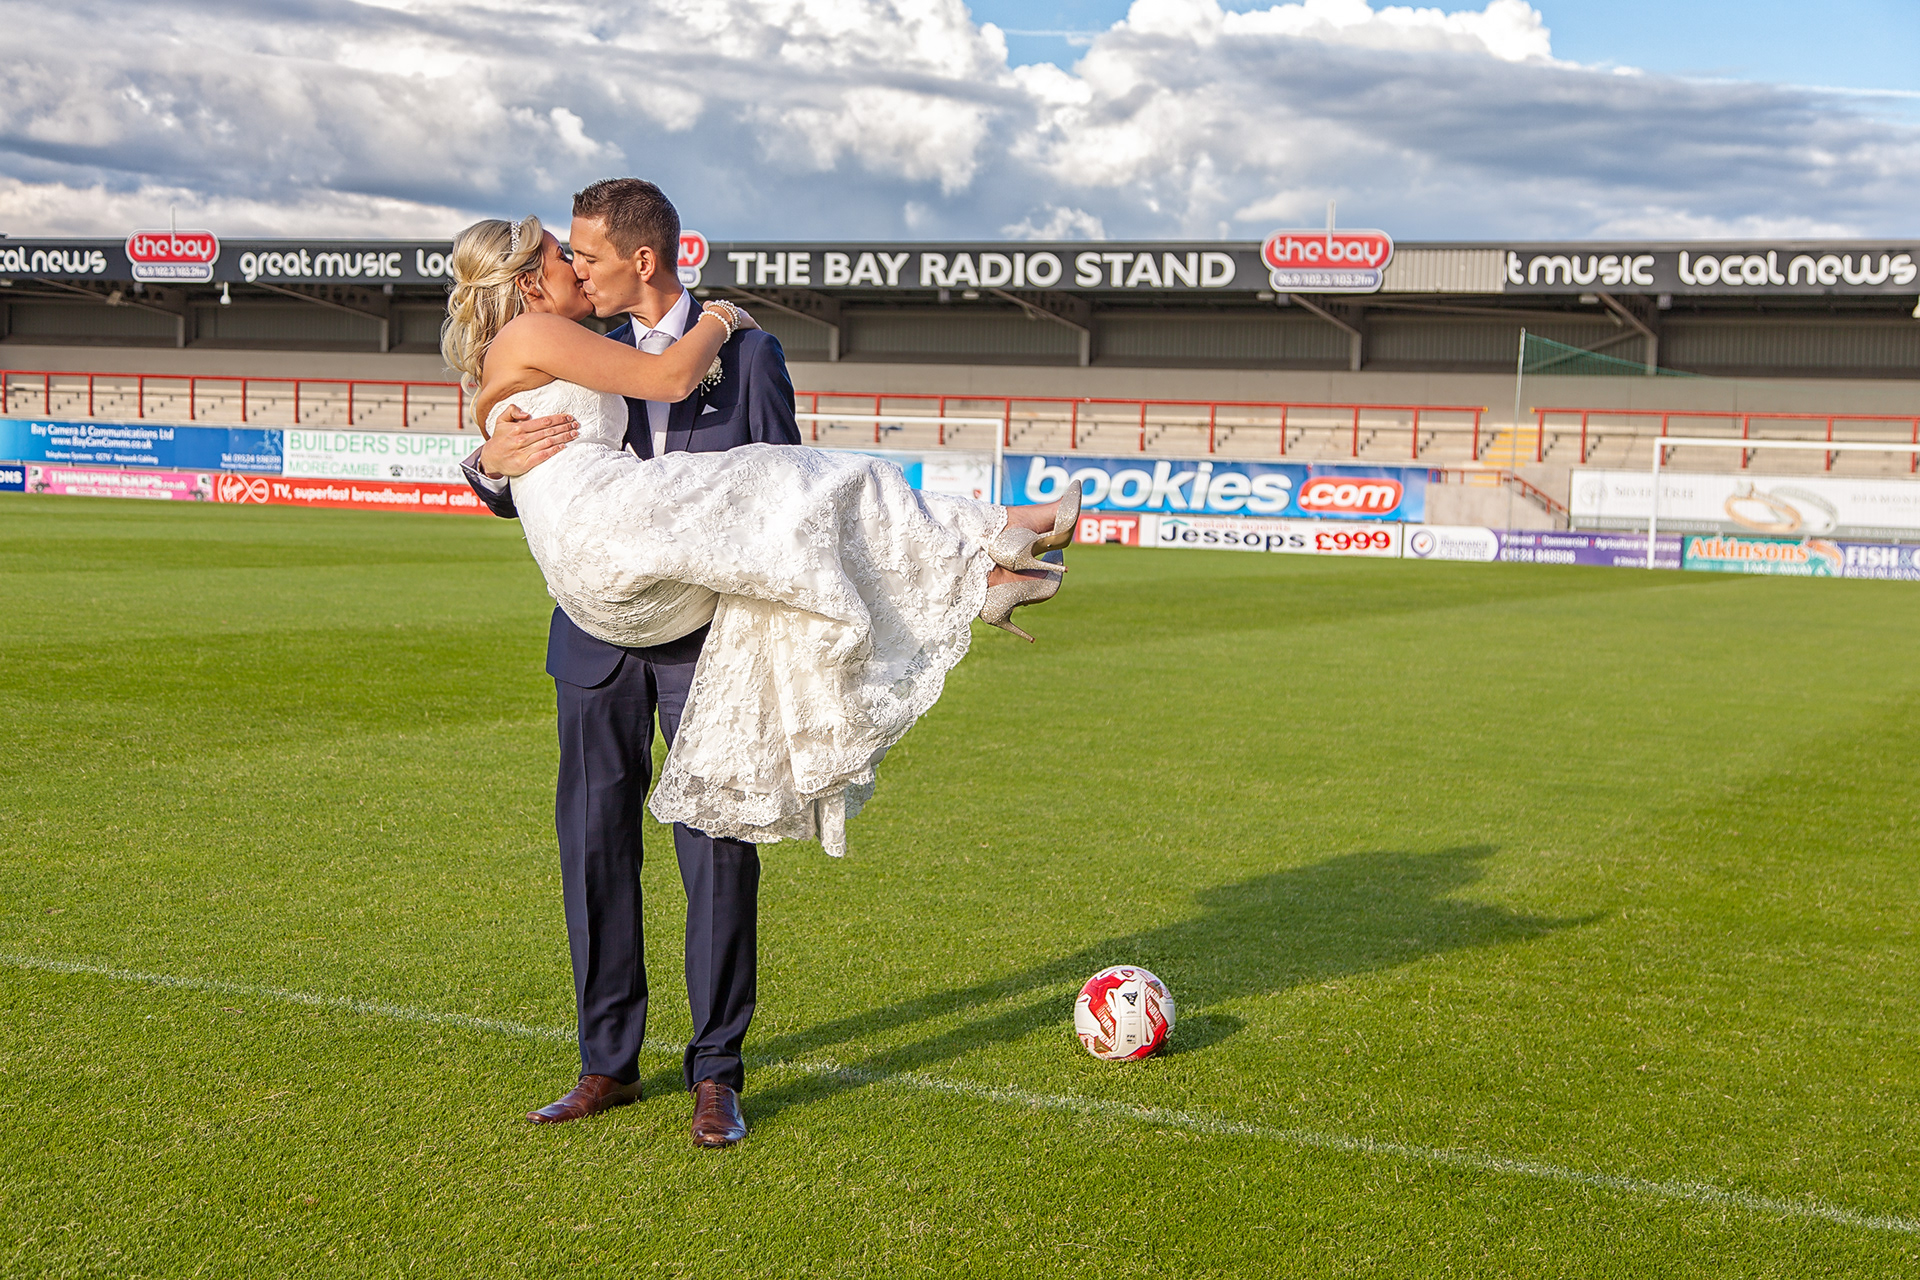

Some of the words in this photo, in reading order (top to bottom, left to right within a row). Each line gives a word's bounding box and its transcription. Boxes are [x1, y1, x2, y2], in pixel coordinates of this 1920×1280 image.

[727, 252, 811, 286] THE
[824, 252, 910, 287] BAY
[920, 252, 1063, 288] RADIO
[1074, 252, 1237, 288] STAND
[1528, 254, 1655, 286] music
[30, 423, 46, 437] Bay
[47, 424, 79, 437] Camera
[80, 426, 87, 436] &
[88, 426, 158, 440] Communications
[159, 428, 174, 441] Ltd
[290, 431, 389, 454] BUILDERS
[289, 460, 379, 477] MORECAMBE
[405, 465, 443, 478] 01524
[273, 483, 292, 500] TV,
[294, 485, 350, 502] superfast
[351, 487, 420, 504] broadband
[422, 490, 447, 505] and
[1025, 456, 1293, 513] bookies
[1300, 483, 1396, 508] .com
[1161, 525, 1306, 551] Jessops
[1315, 531, 1391, 550] £999
[1687, 537, 1810, 562] Atkinsons
[1846, 545, 1899, 568] FISH
